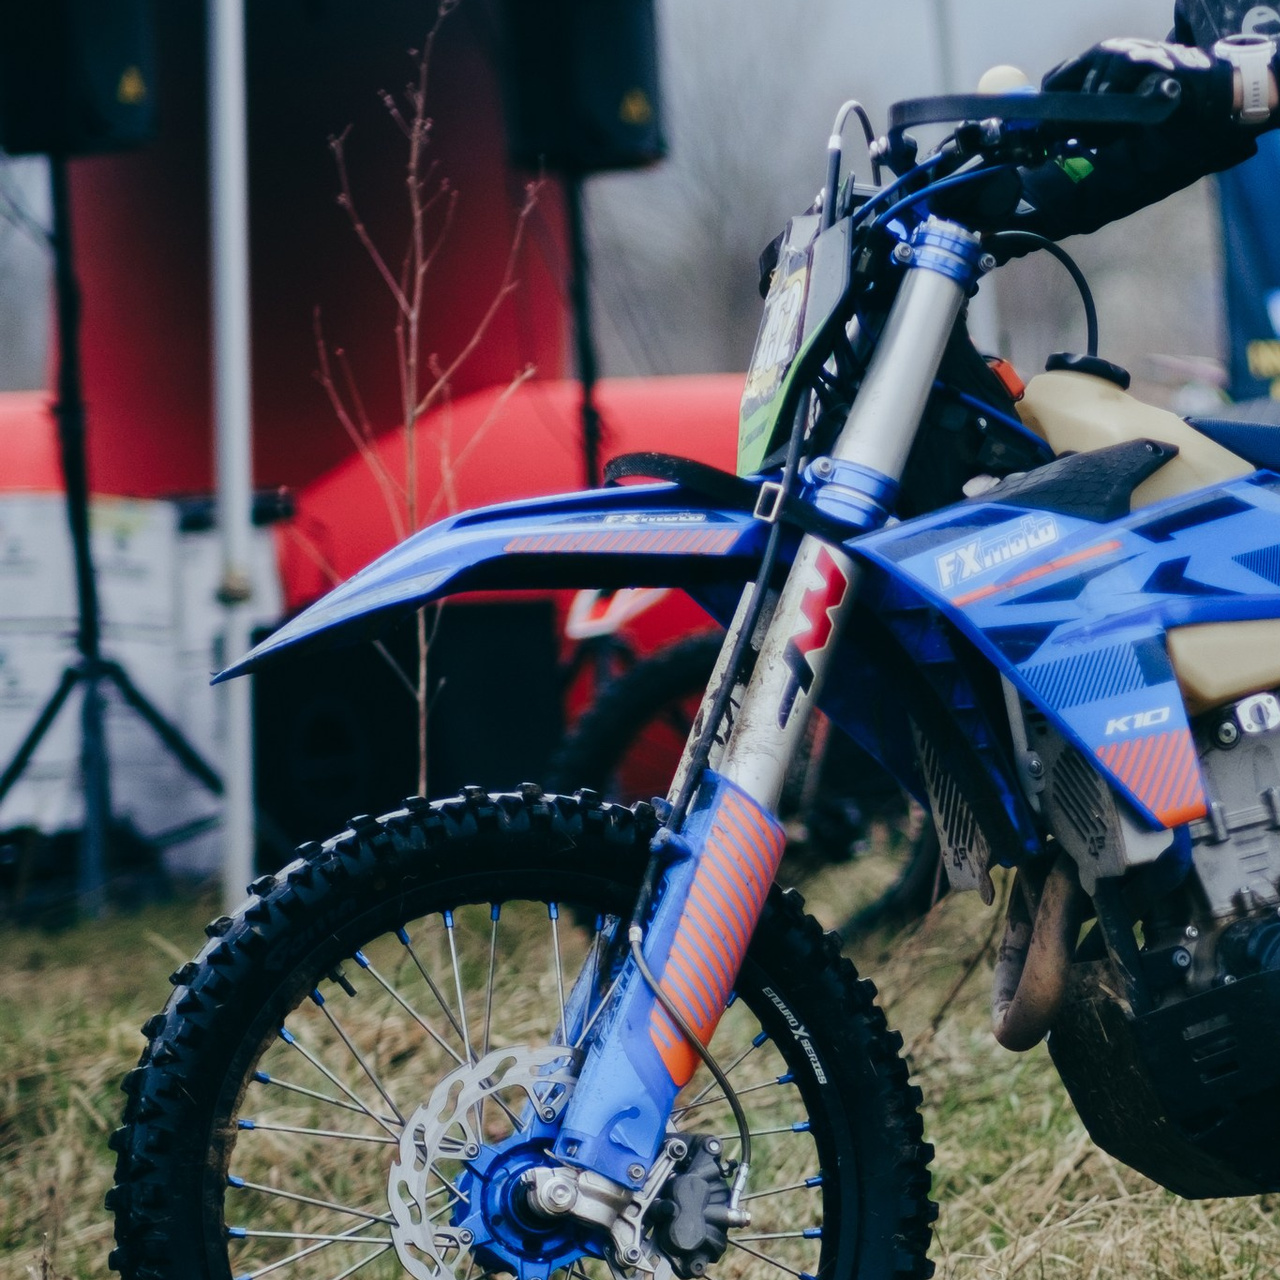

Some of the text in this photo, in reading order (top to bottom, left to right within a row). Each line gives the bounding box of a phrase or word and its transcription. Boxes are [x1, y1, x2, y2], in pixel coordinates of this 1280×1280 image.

[934, 515, 1060, 592] FXmoto
[1105, 706, 1171, 736] K10
[762, 986, 799, 1027] ENDURO
[800, 1038, 828, 1085] SERIES
